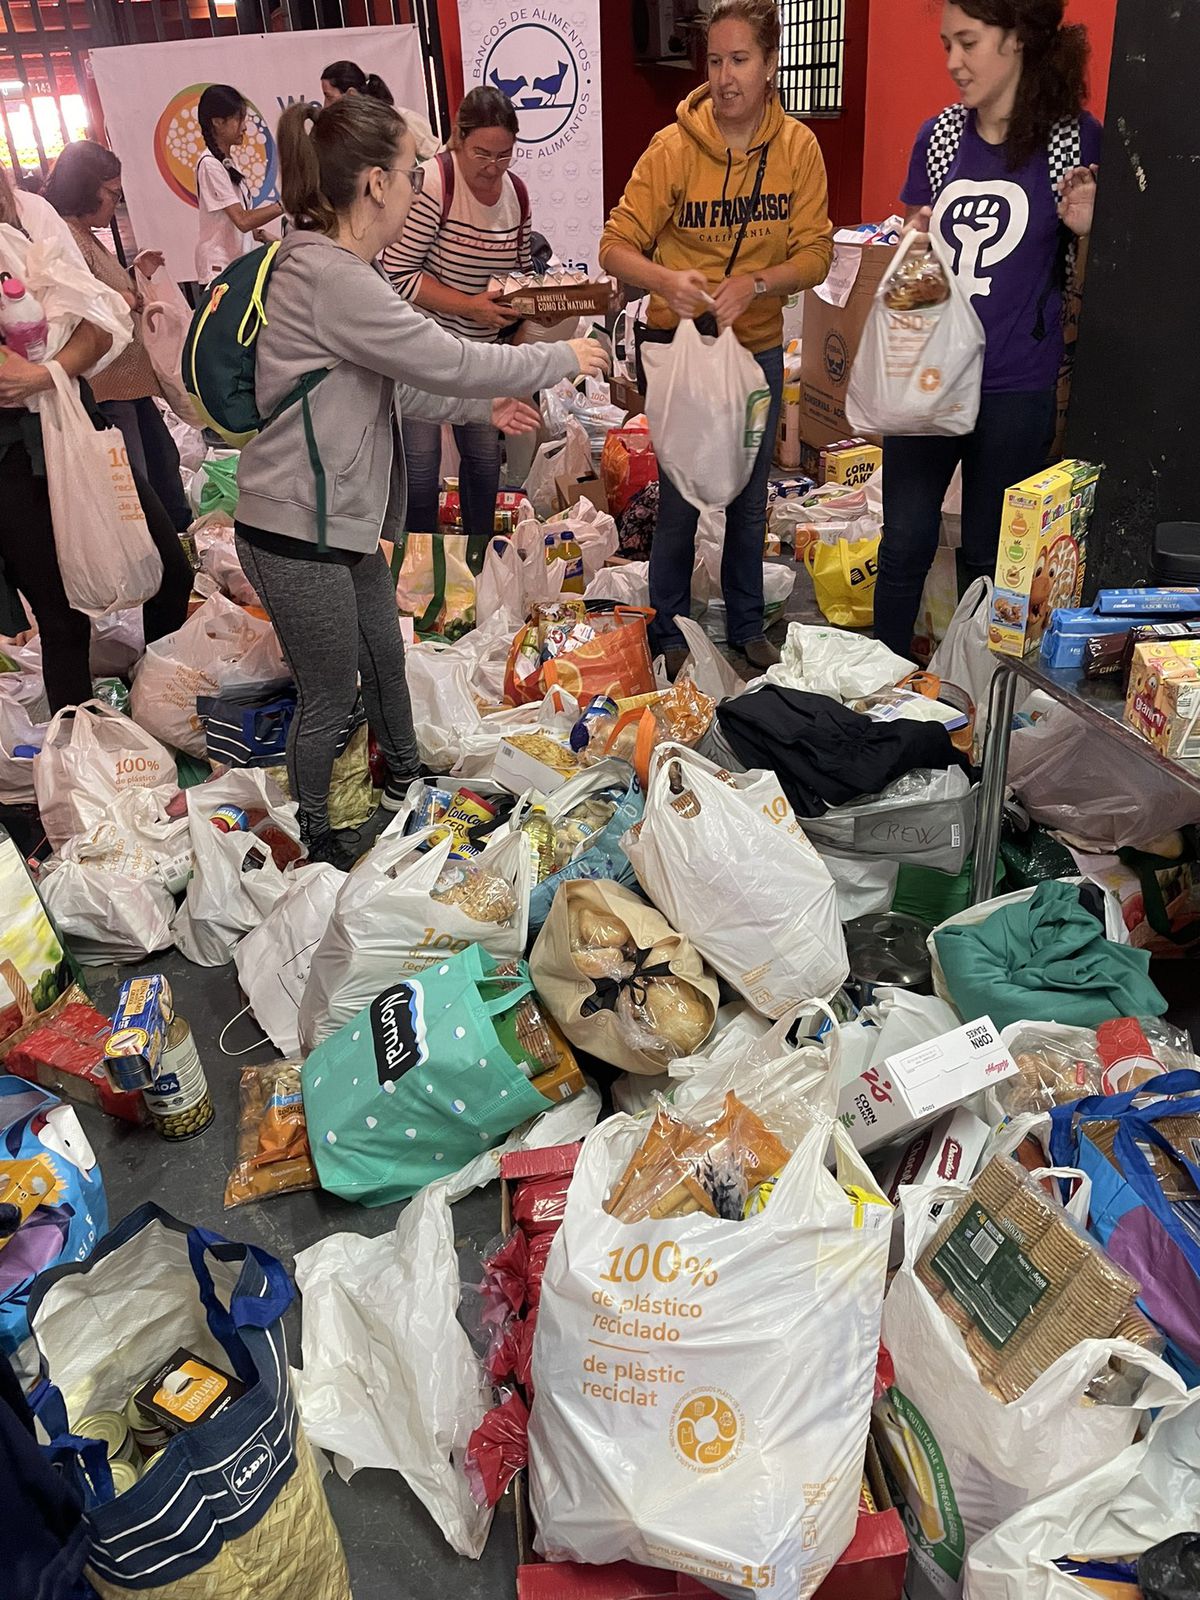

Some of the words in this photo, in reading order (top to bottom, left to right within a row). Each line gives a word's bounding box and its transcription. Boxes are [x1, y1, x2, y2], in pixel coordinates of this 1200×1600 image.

[473, 18, 507, 78] BANCOS
[510, 8, 528, 22] DE
[532, 8, 591, 72] ALIMENTOS
[516, 147, 533, 159] DE
[537, 93, 590, 158] ALIMENTOS
[538, 302, 557, 312] COMO
[557, 302, 566, 311] ES
[566, 299, 596, 311] NATURAL
[845, 462, 875, 477] CORN
[115, 757, 160, 776] 100%
[870, 821, 946, 845] CREW
[379, 992, 411, 1069] Normal
[965, 1025, 987, 1039] FLAKES
[970, 1034, 994, 1050] CORN
[854, 1097, 873, 1127] FLAKES
[858, 1094, 878, 1125] CORN
[600, 1240, 718, 1287] 100%
[591, 1290, 615, 1307] de
[619, 1292, 703, 1318] plástico
[592, 1312, 680, 1342] reciclado
[583, 1354, 608, 1374] de
[614, 1361, 686, 1384] plàstic
[582, 1380, 658, 1408] reciclat
